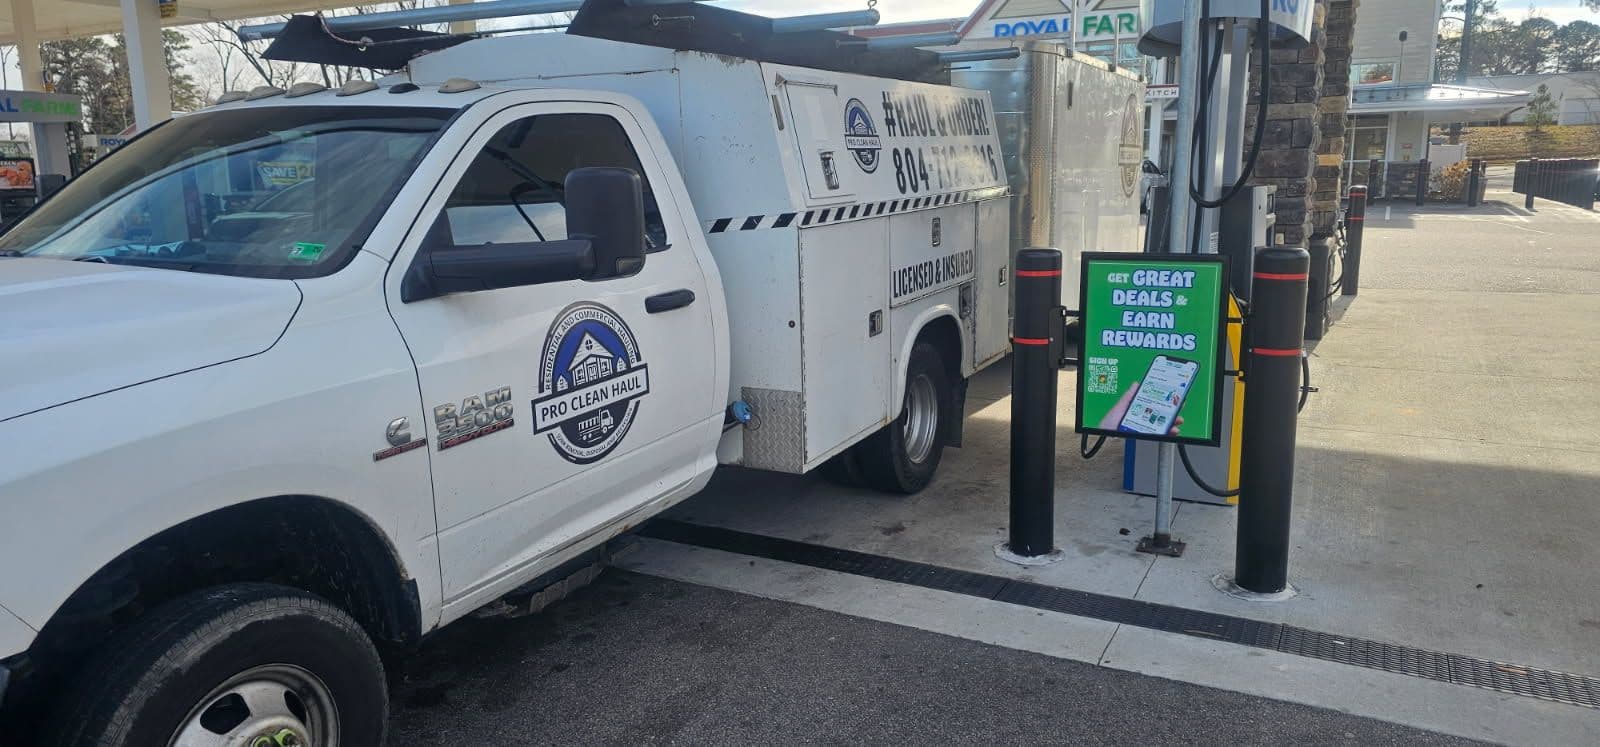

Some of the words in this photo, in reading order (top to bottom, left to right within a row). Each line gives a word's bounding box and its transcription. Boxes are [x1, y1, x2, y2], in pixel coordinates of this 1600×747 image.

[882, 92, 936, 137] #HAUL
[263, 167, 297, 178] SAVE
[893, 261, 934, 298] LICENSED
[935, 259, 941, 284] &
[942, 249, 974, 282] INSURED
[1107, 273, 1129, 283] GET
[1132, 270, 1195, 287] GREAT
[1112, 289, 1173, 307] DEALS
[1176, 295, 1188, 305] &
[1122, 310, 1175, 329] EARN
[545, 331, 563, 390] RESIDENTIAL
[561, 317, 575, 330] AND
[575, 311, 617, 329] COMMERCIAL
[1102, 329, 1196, 351] REWARDS
[434, 386, 512, 424] RAM
[541, 401, 567, 422] PRO
[571, 389, 609, 411] CLEAN
[612, 376, 642, 396] HAUL
[436, 402, 514, 440] 3500
